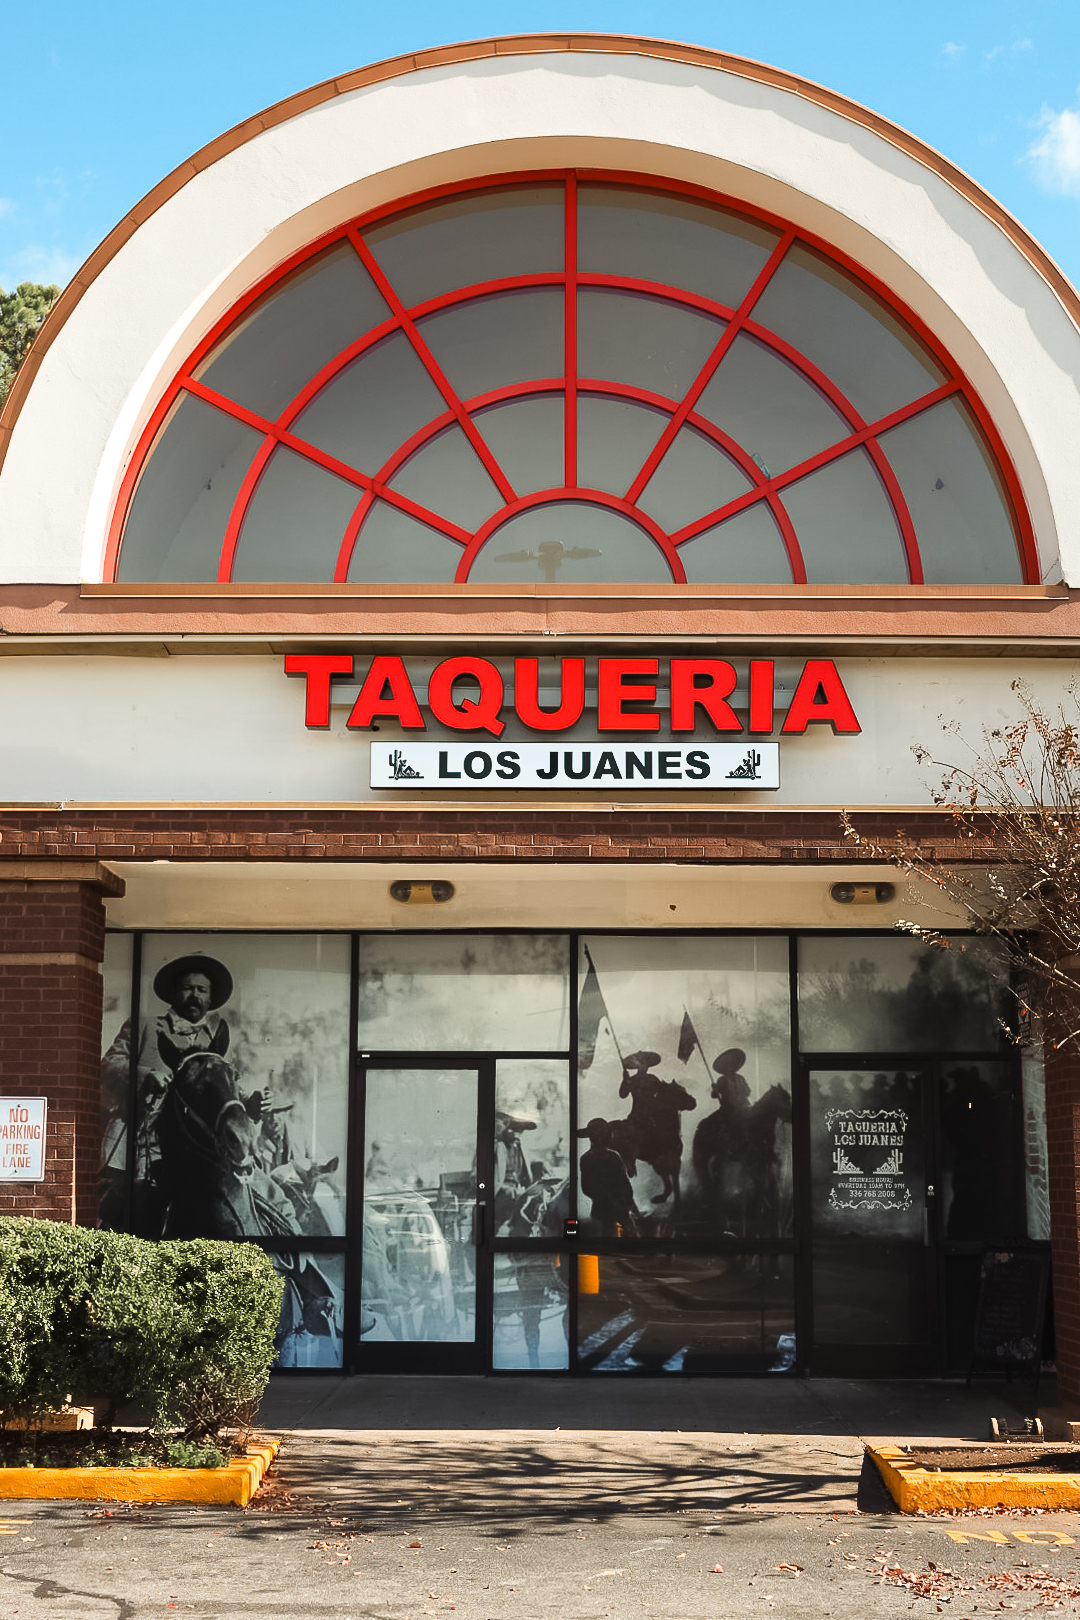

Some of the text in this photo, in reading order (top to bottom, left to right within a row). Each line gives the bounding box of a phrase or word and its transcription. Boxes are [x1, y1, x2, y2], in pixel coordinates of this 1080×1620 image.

[284, 655, 862, 738] TAQUERIA
[438, 750, 711, 780] LOS JUANES
[9, 1108, 29, 1122] NO
[839, 1122, 898, 1133] TAQUERIA
[834, 1135, 904, 1146] LOS JUANES
[6, 1143, 29, 1154] FIRE
[2, 1156, 31, 1167] LANE
[945, 1529, 1077, 1545] NO
